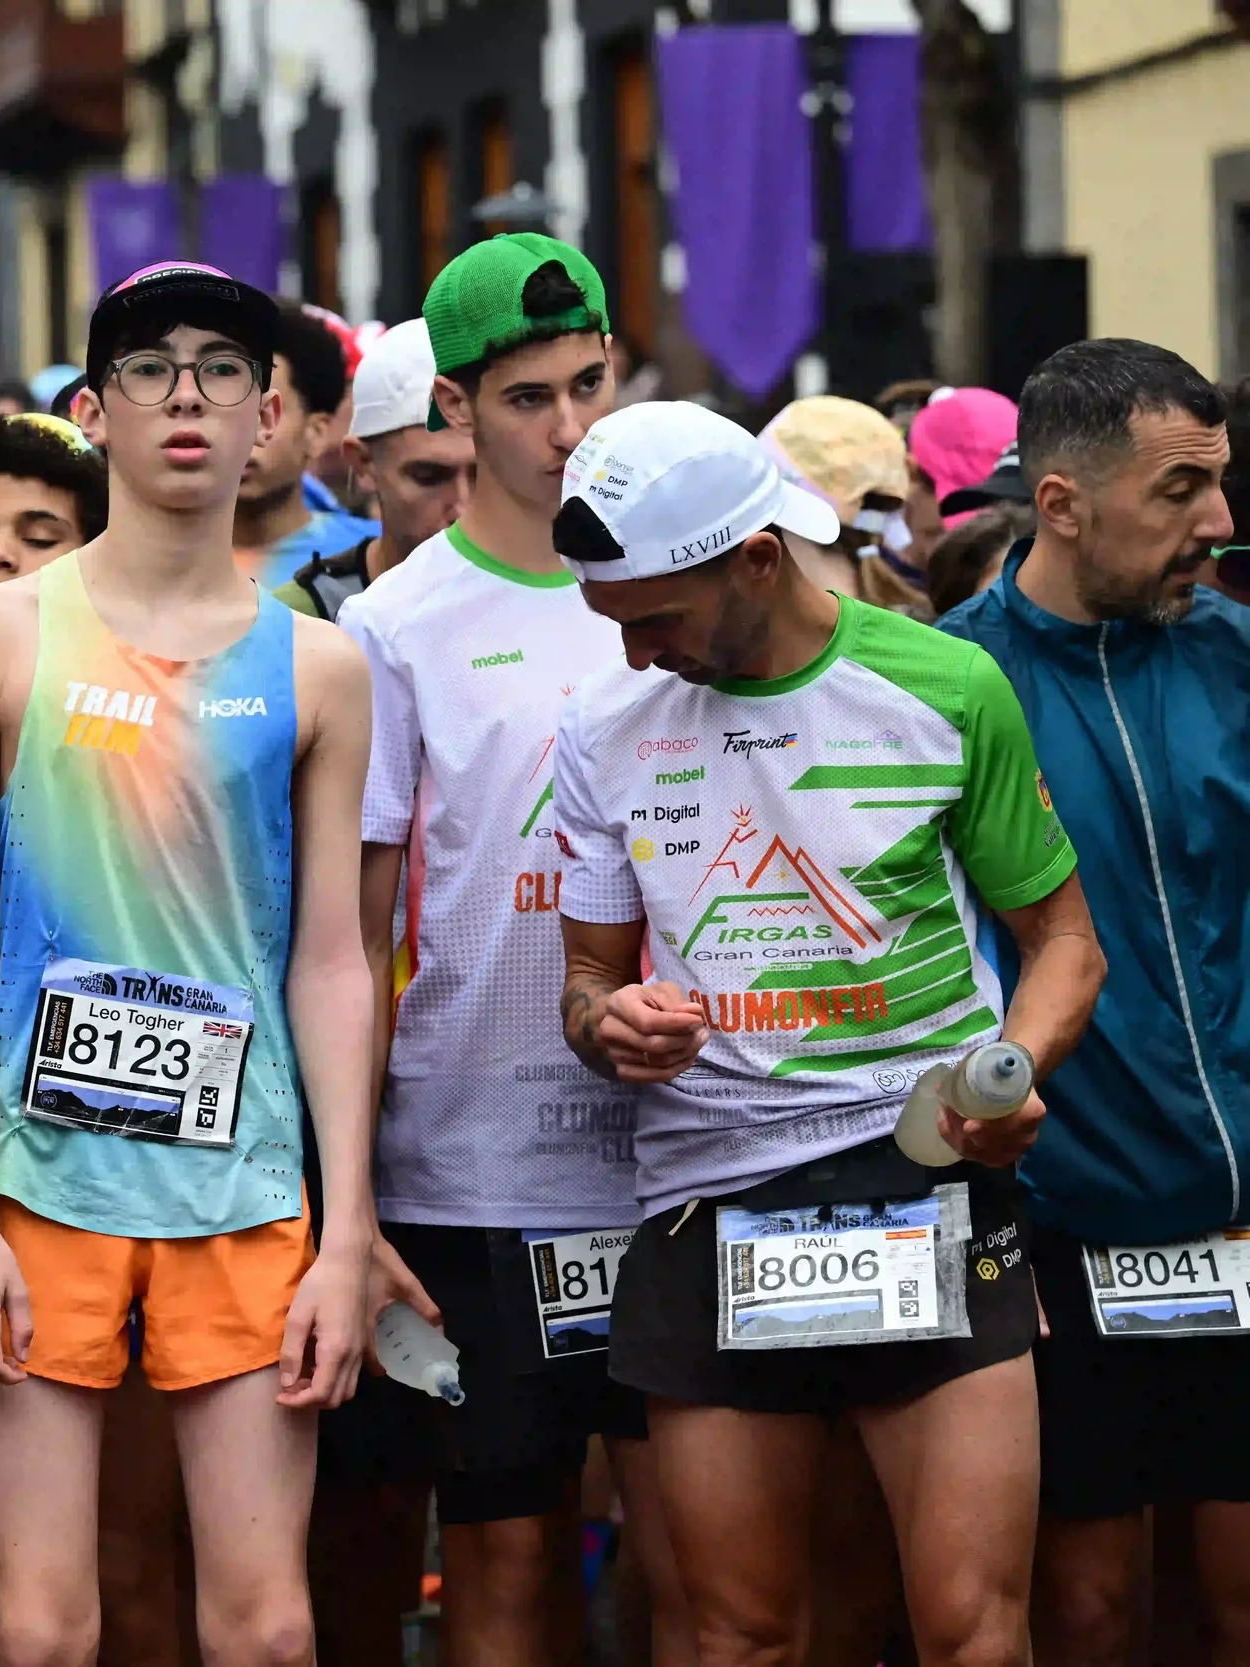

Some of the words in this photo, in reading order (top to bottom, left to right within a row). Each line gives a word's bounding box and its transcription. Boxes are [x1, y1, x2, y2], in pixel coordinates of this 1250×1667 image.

[607, 475, 629, 487] DMP
[597, 487, 624, 501] Digital
[670, 526, 732, 564] LXVIII
[471, 649, 524, 669] mobel
[64, 681, 159, 726] TRAIL
[198, 697, 267, 718] HOKA
[64, 714, 144, 757] FAM
[652, 737, 699, 752] abaco
[723, 730, 797, 759] Firprint
[655, 765, 705, 785] mobel
[654, 804, 700, 823] Digital
[665, 841, 700, 856] DMP
[694, 950, 753, 962] Gran
[762, 945, 853, 958] Canaria
[74, 976, 103, 985] NORTH
[88, 971, 104, 979] THE
[80, 983, 101, 994] FACE
[121, 973, 185, 1008] TRANS
[186, 987, 214, 1001] GRAN
[184, 999, 228, 1014] CANARIA
[49, 1001, 61, 1040] EMERGENCIAS
[89, 1003, 121, 1021] Leo
[127, 1009, 185, 1032] Togher
[68, 1023, 191, 1081] 8123
[38, 1059, 63, 1069] Arista
[794, 1234, 844, 1249] RAÚL
[986, 1222, 1017, 1249] Digital
[1002, 1248, 1022, 1268] DMP
[758, 1249, 881, 1291] 8006
[1115, 1249, 1220, 1288] 8041
[562, 1257, 609, 1301] 81
